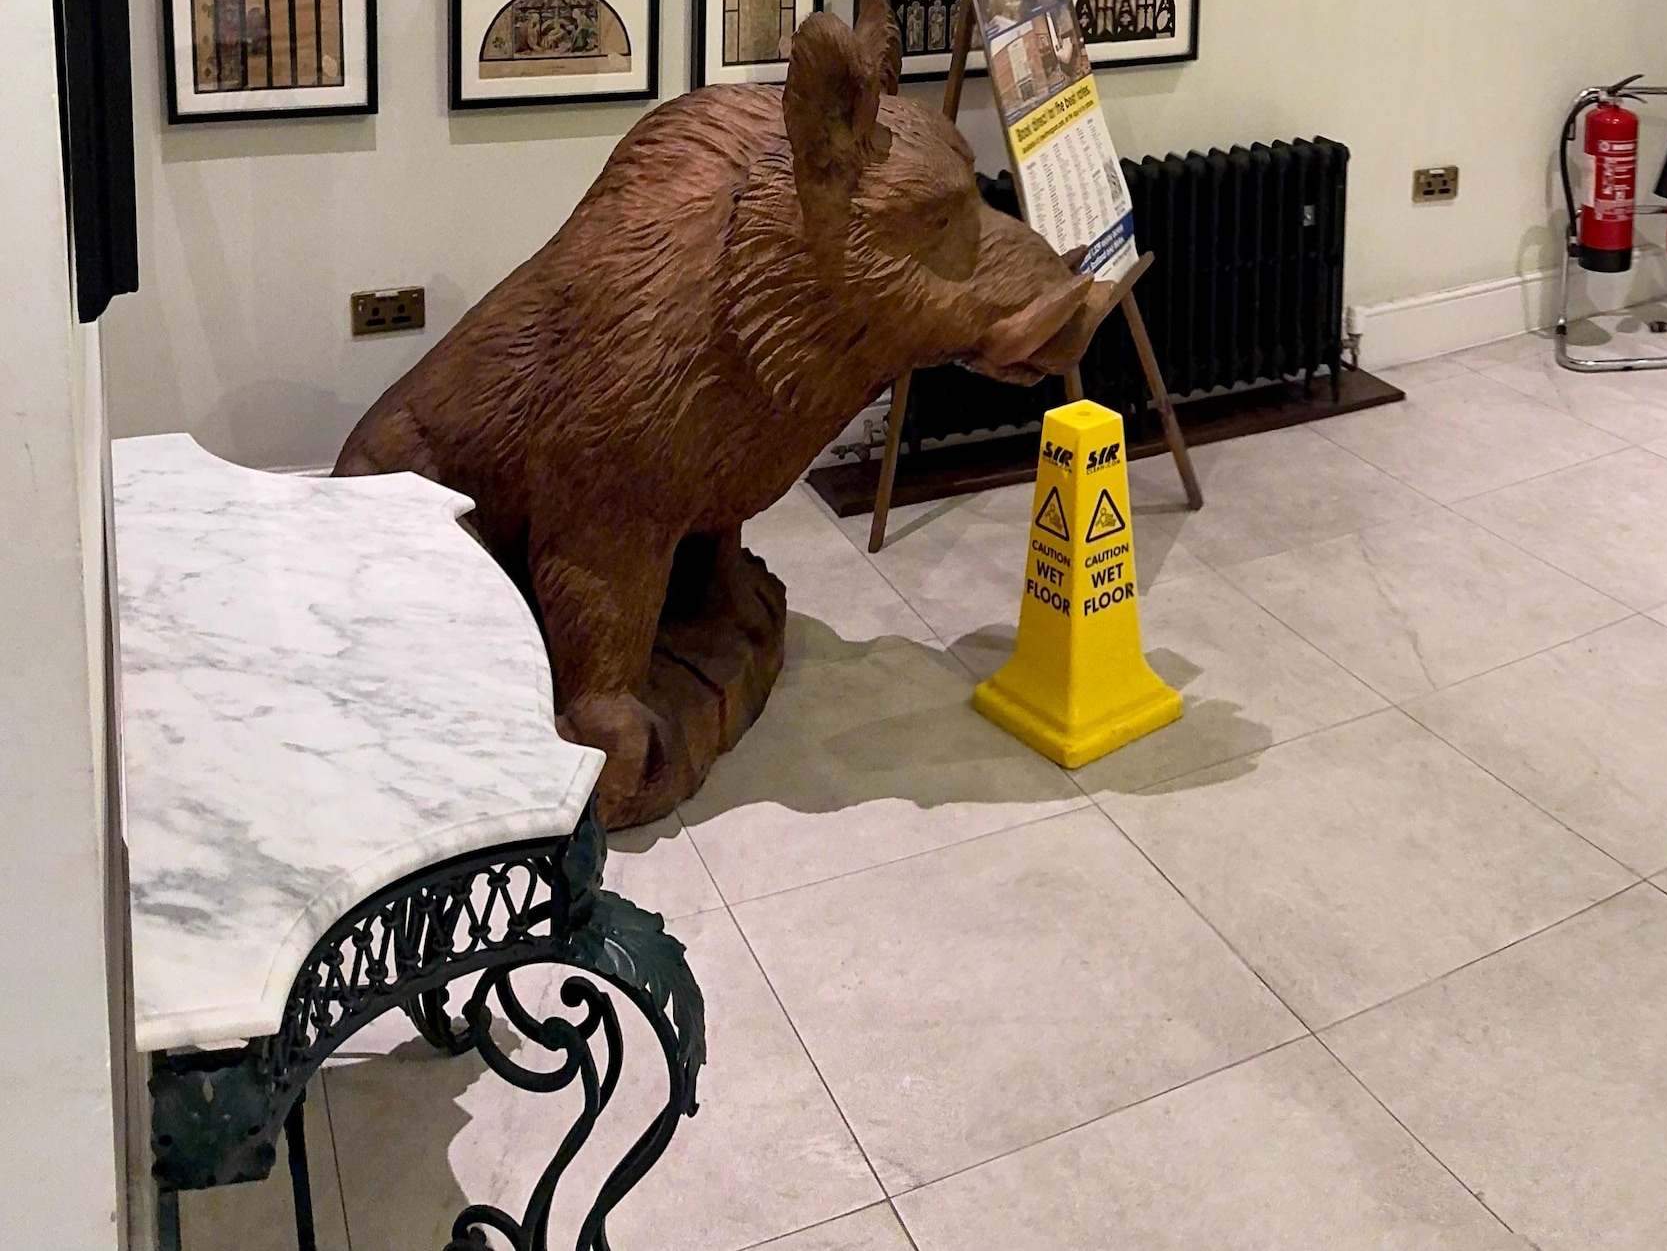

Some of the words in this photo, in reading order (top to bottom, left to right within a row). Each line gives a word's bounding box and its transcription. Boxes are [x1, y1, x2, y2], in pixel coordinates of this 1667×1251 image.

[1042, 440, 1074, 467] SIR
[1085, 442, 1121, 470] SIR
[1031, 539, 1071, 568] CAUTION
[1084, 542, 1130, 569] CAUTION
[1036, 558, 1065, 587] WET
[1091, 562, 1124, 589] WET
[1026, 578, 1071, 617] FLOOR
[1083, 582, 1135, 617] FLOOR
